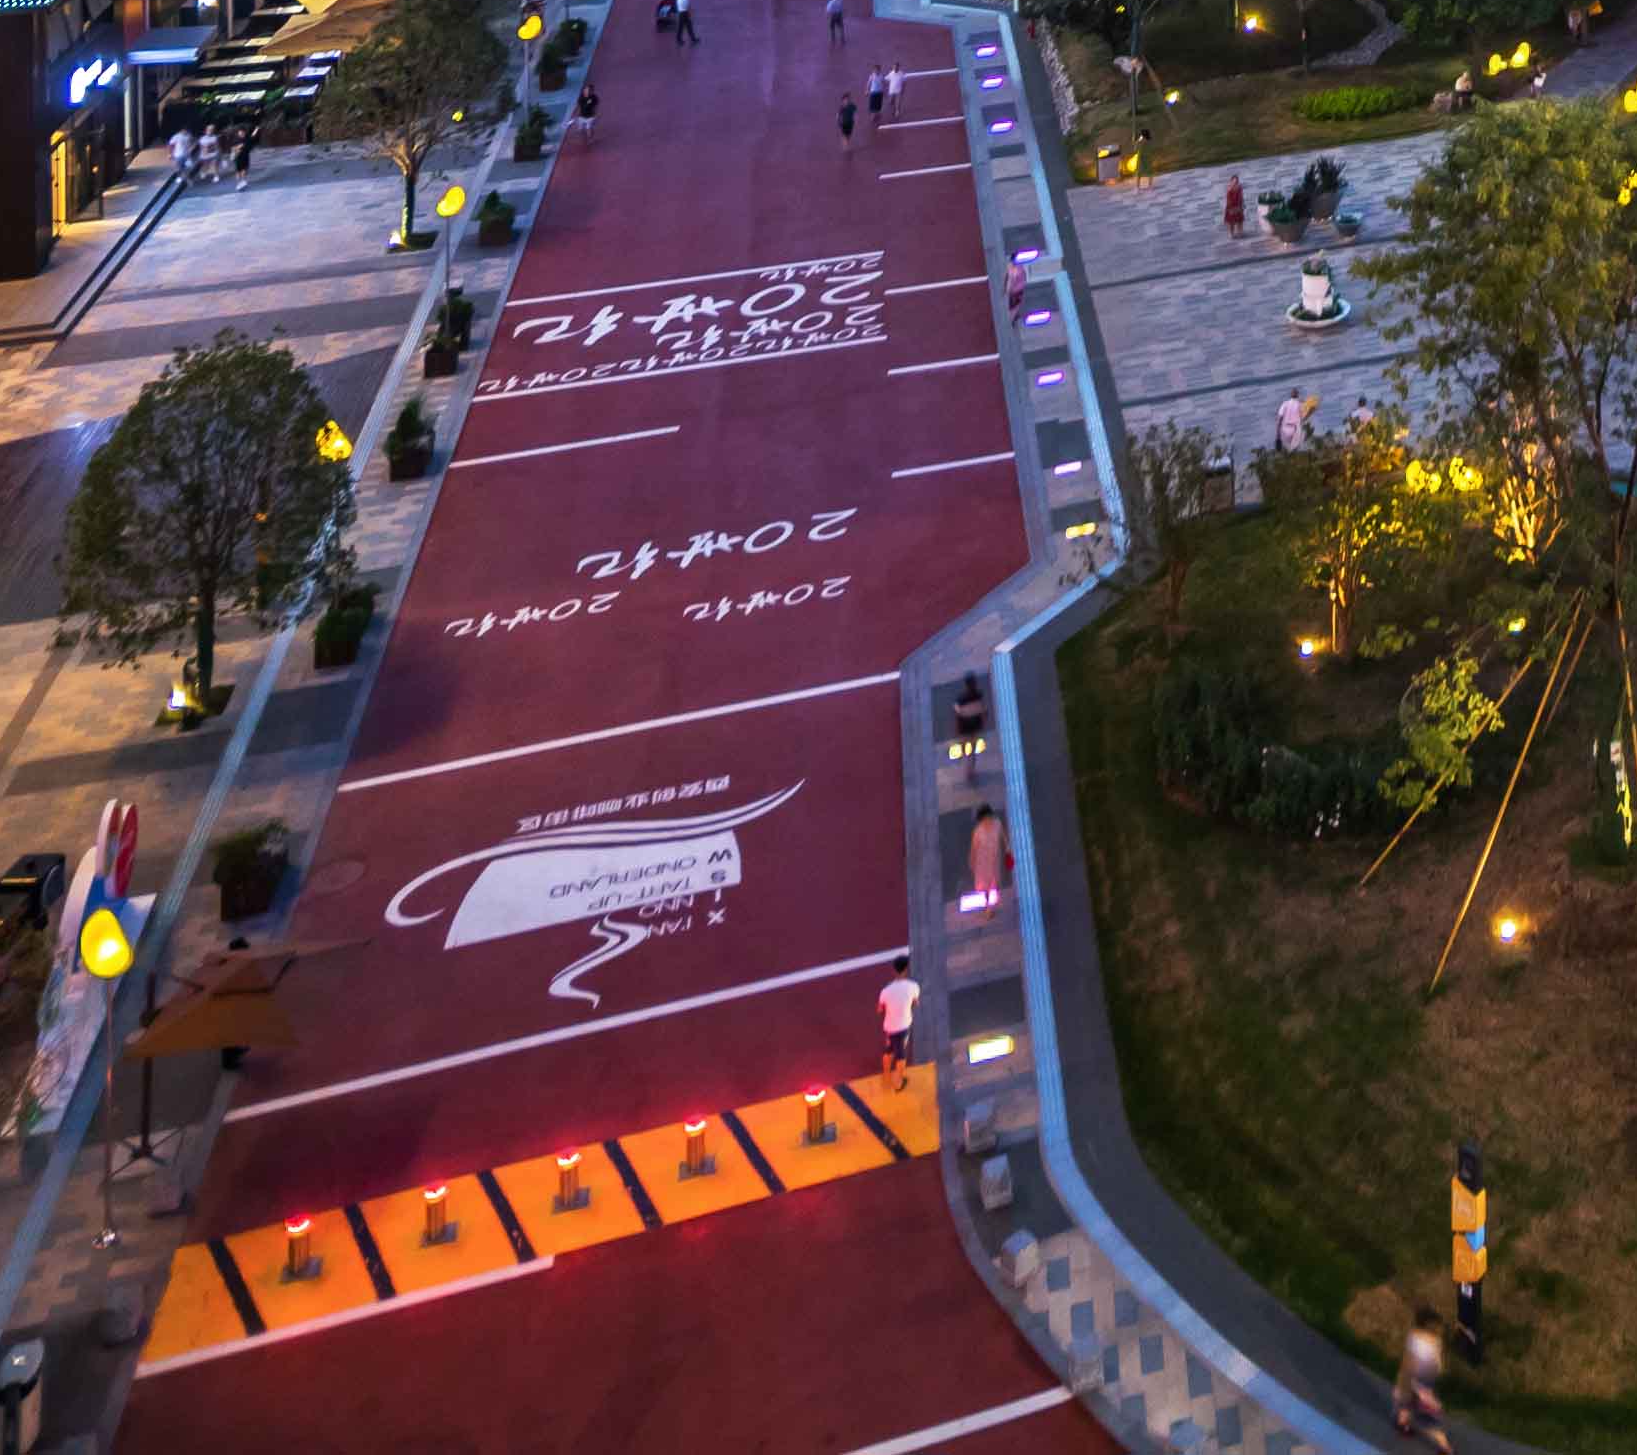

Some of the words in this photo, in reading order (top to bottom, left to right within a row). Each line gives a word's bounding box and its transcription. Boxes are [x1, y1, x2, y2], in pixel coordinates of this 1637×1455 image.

[513, 270, 884, 348] 20世纪
[575, 506, 859, 580] 20世纪
[443, 590, 621, 638] 20世纪
[682, 575, 852, 623] 20世纪
